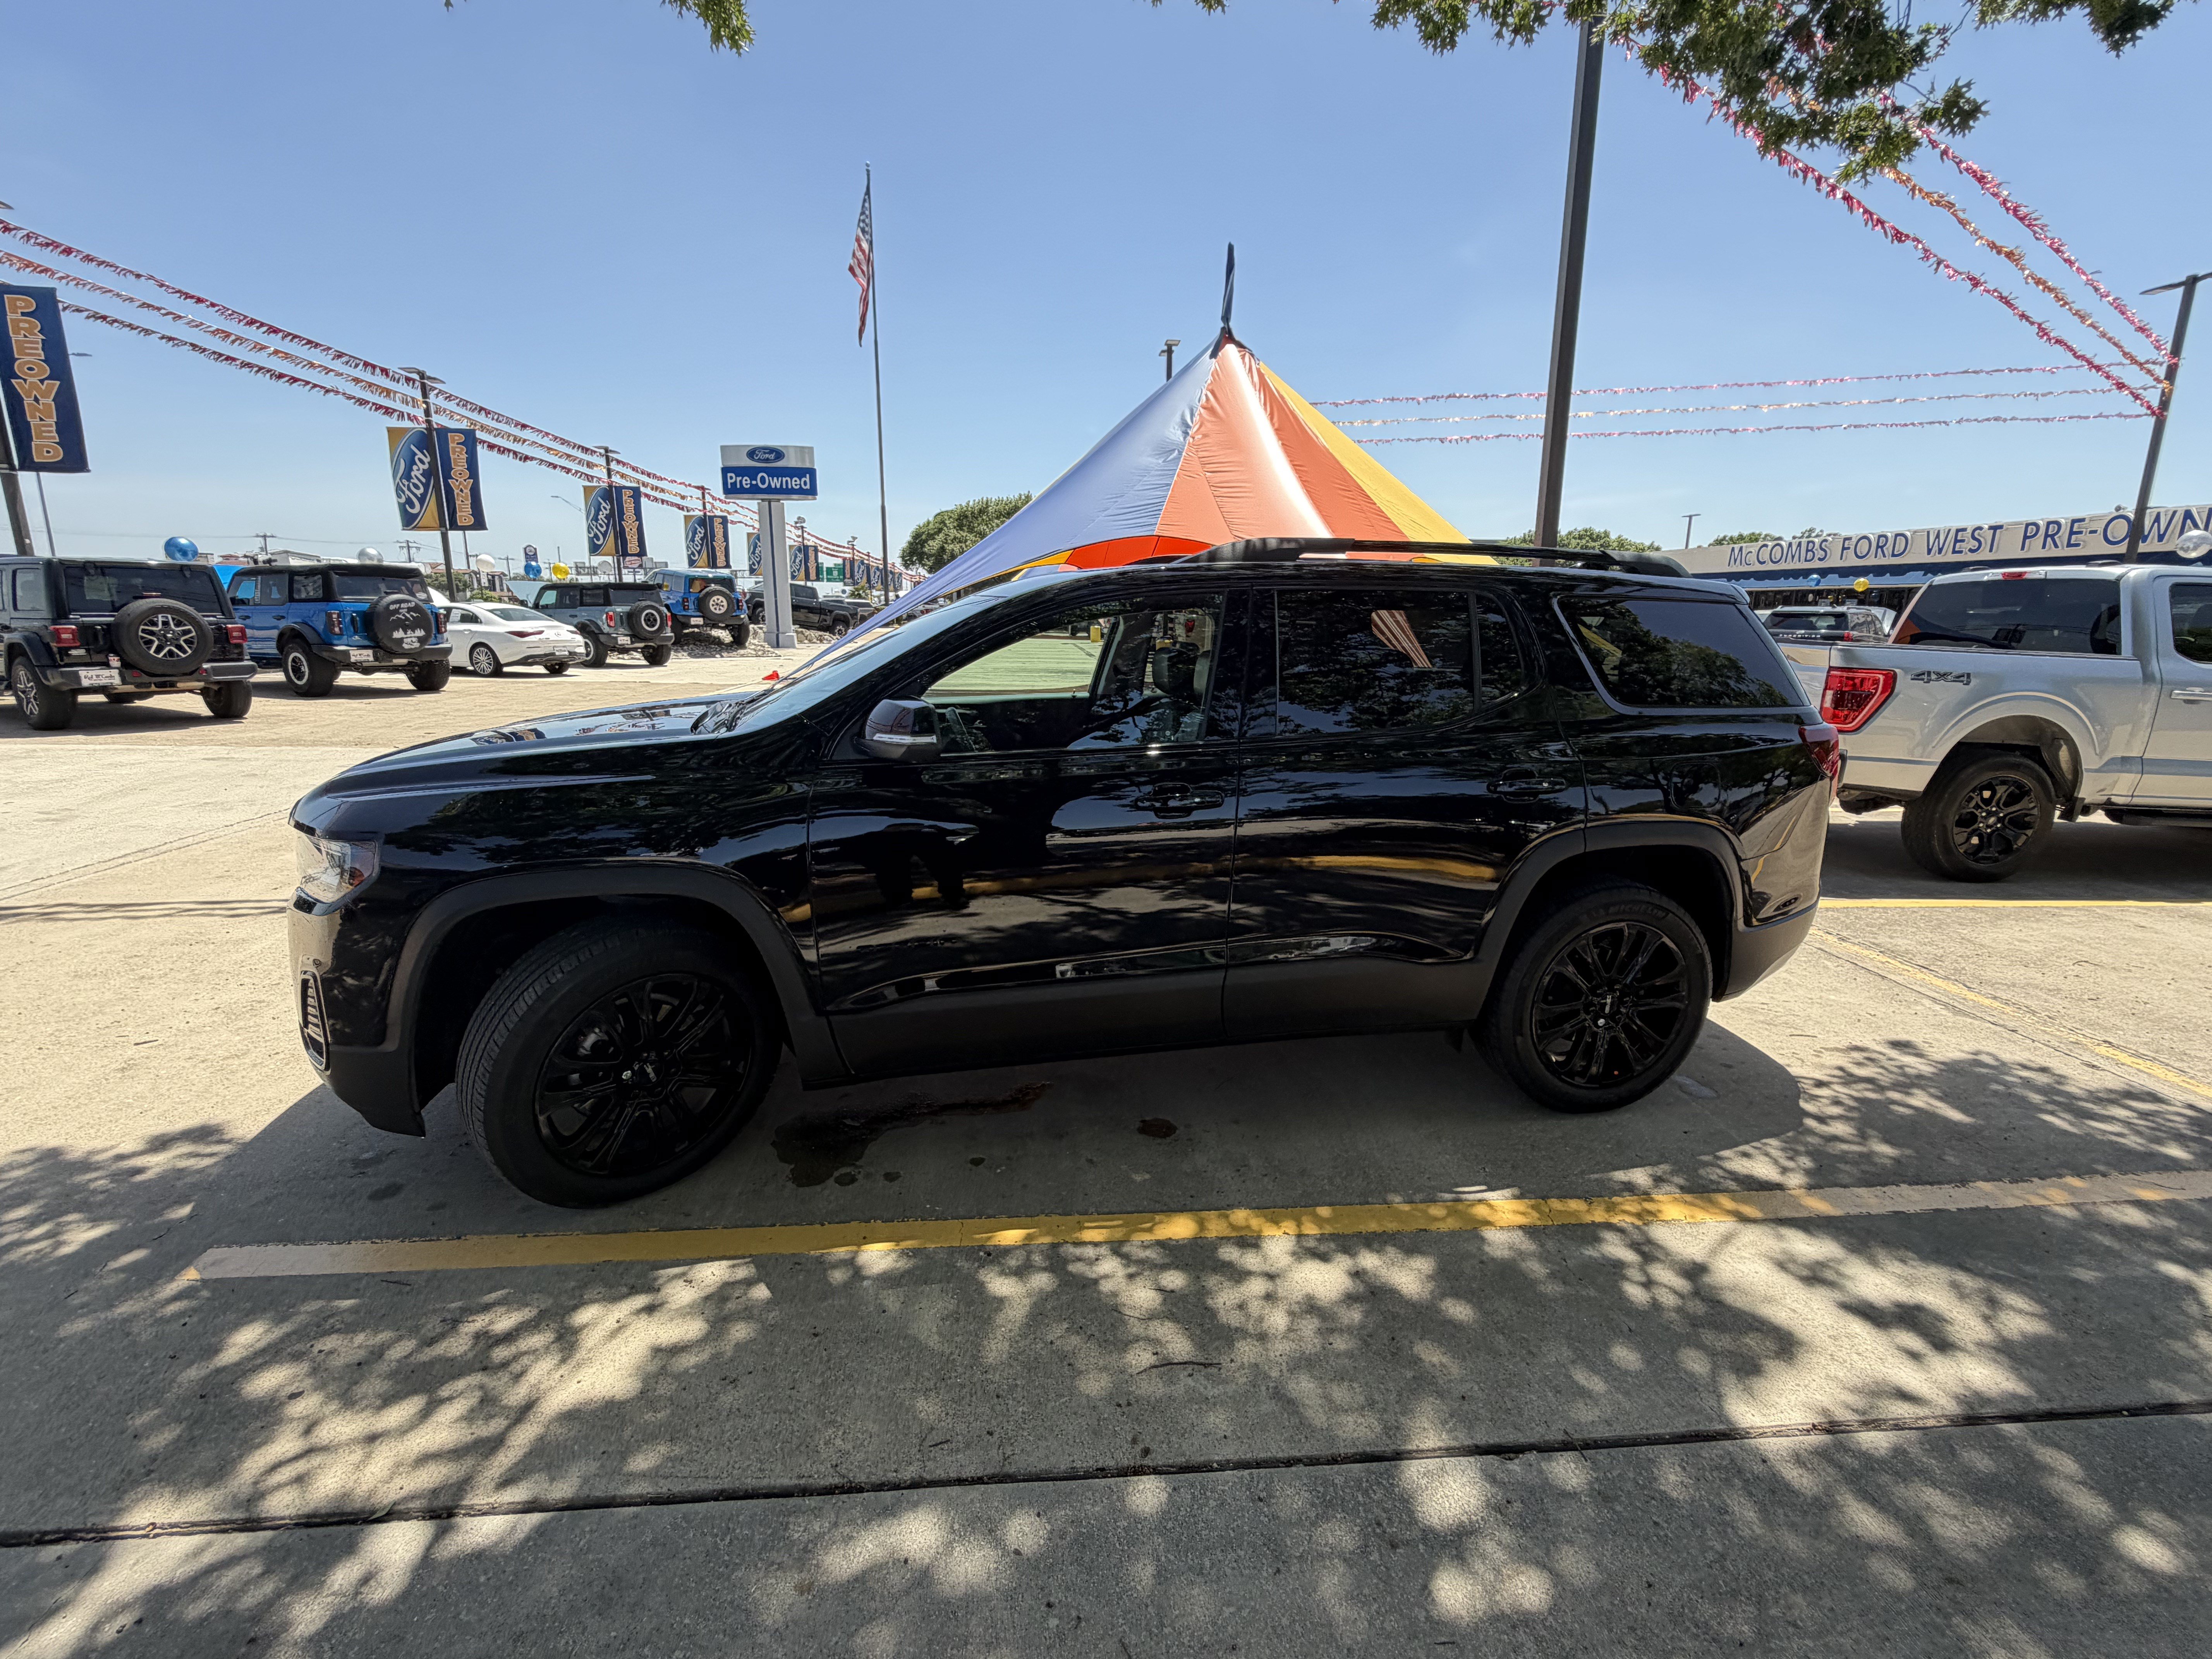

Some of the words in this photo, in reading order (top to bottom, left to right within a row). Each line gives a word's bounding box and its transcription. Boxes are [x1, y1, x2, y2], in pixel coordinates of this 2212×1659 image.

[4, 294, 63, 462] PREOWNED
[754, 449, 775, 460] Ford
[395, 444, 431, 514] Ford
[448, 433, 474, 526] PREOWNED
[727, 472, 810, 489] Pre-Owned
[587, 496, 611, 544] Ford
[622, 489, 640, 553] PREOWNED
[687, 524, 704, 560] Ford
[749, 539, 762, 569] Ford
[1840, 532, 1909, 561] FORD
[1927, 524, 2004, 556] WEST
